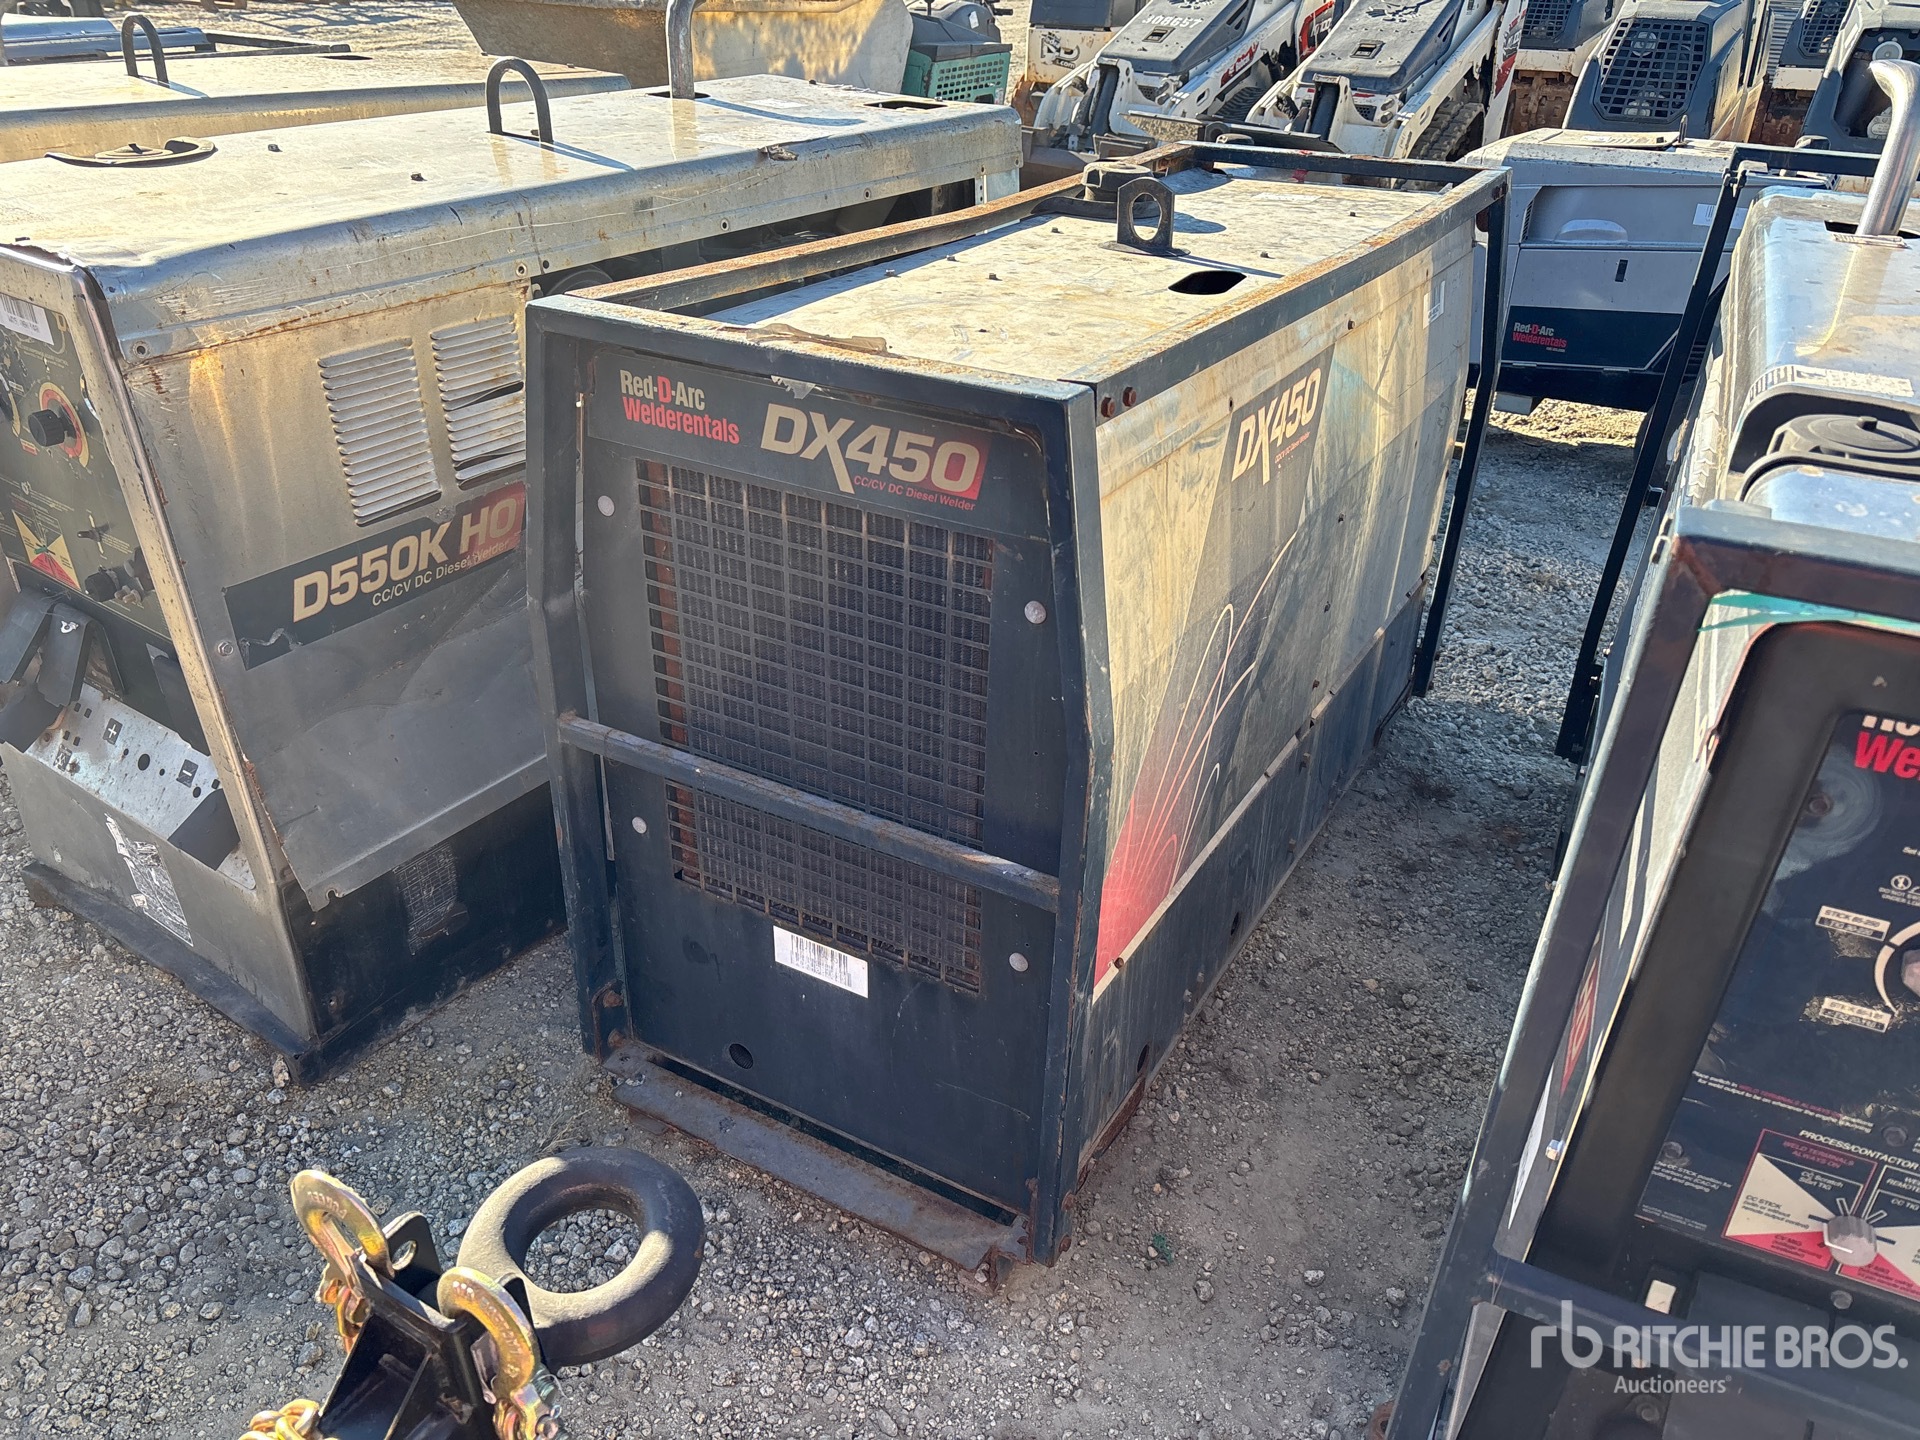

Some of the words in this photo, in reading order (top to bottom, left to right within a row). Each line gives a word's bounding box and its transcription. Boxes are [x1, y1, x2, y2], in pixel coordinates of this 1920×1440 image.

[1142, 14, 1202, 29] 308657
[1512, 331, 1568, 348] Welderentals
[1513, 322, 1555, 337] Red-D-Arc
[619, 369, 705, 411] Red-D-Arc
[622, 396, 740, 444] Welderentals
[1231, 367, 1322, 486] DX450
[761, 402, 980, 494] DX450
[853, 475, 887, 491] CC/CV
[887, 482, 905, 495] DC
[906, 485, 938, 504] Diesel
[939, 493, 976, 511] Welder
[292, 521, 453, 623] D550K
[459, 497, 518, 555] HO
[372, 578, 412, 606] CC/CV
[414, 570, 433, 588] DC
[1799, 1129, 1919, 1170] PROCESS/CONTACTOR
[1679, 1168, 1697, 1176] STICK
[1815, 1175, 1843, 1187] Scratch
[1819, 1183, 1832, 1191] TIG
[1759, 1198, 1781, 1209] STICK
